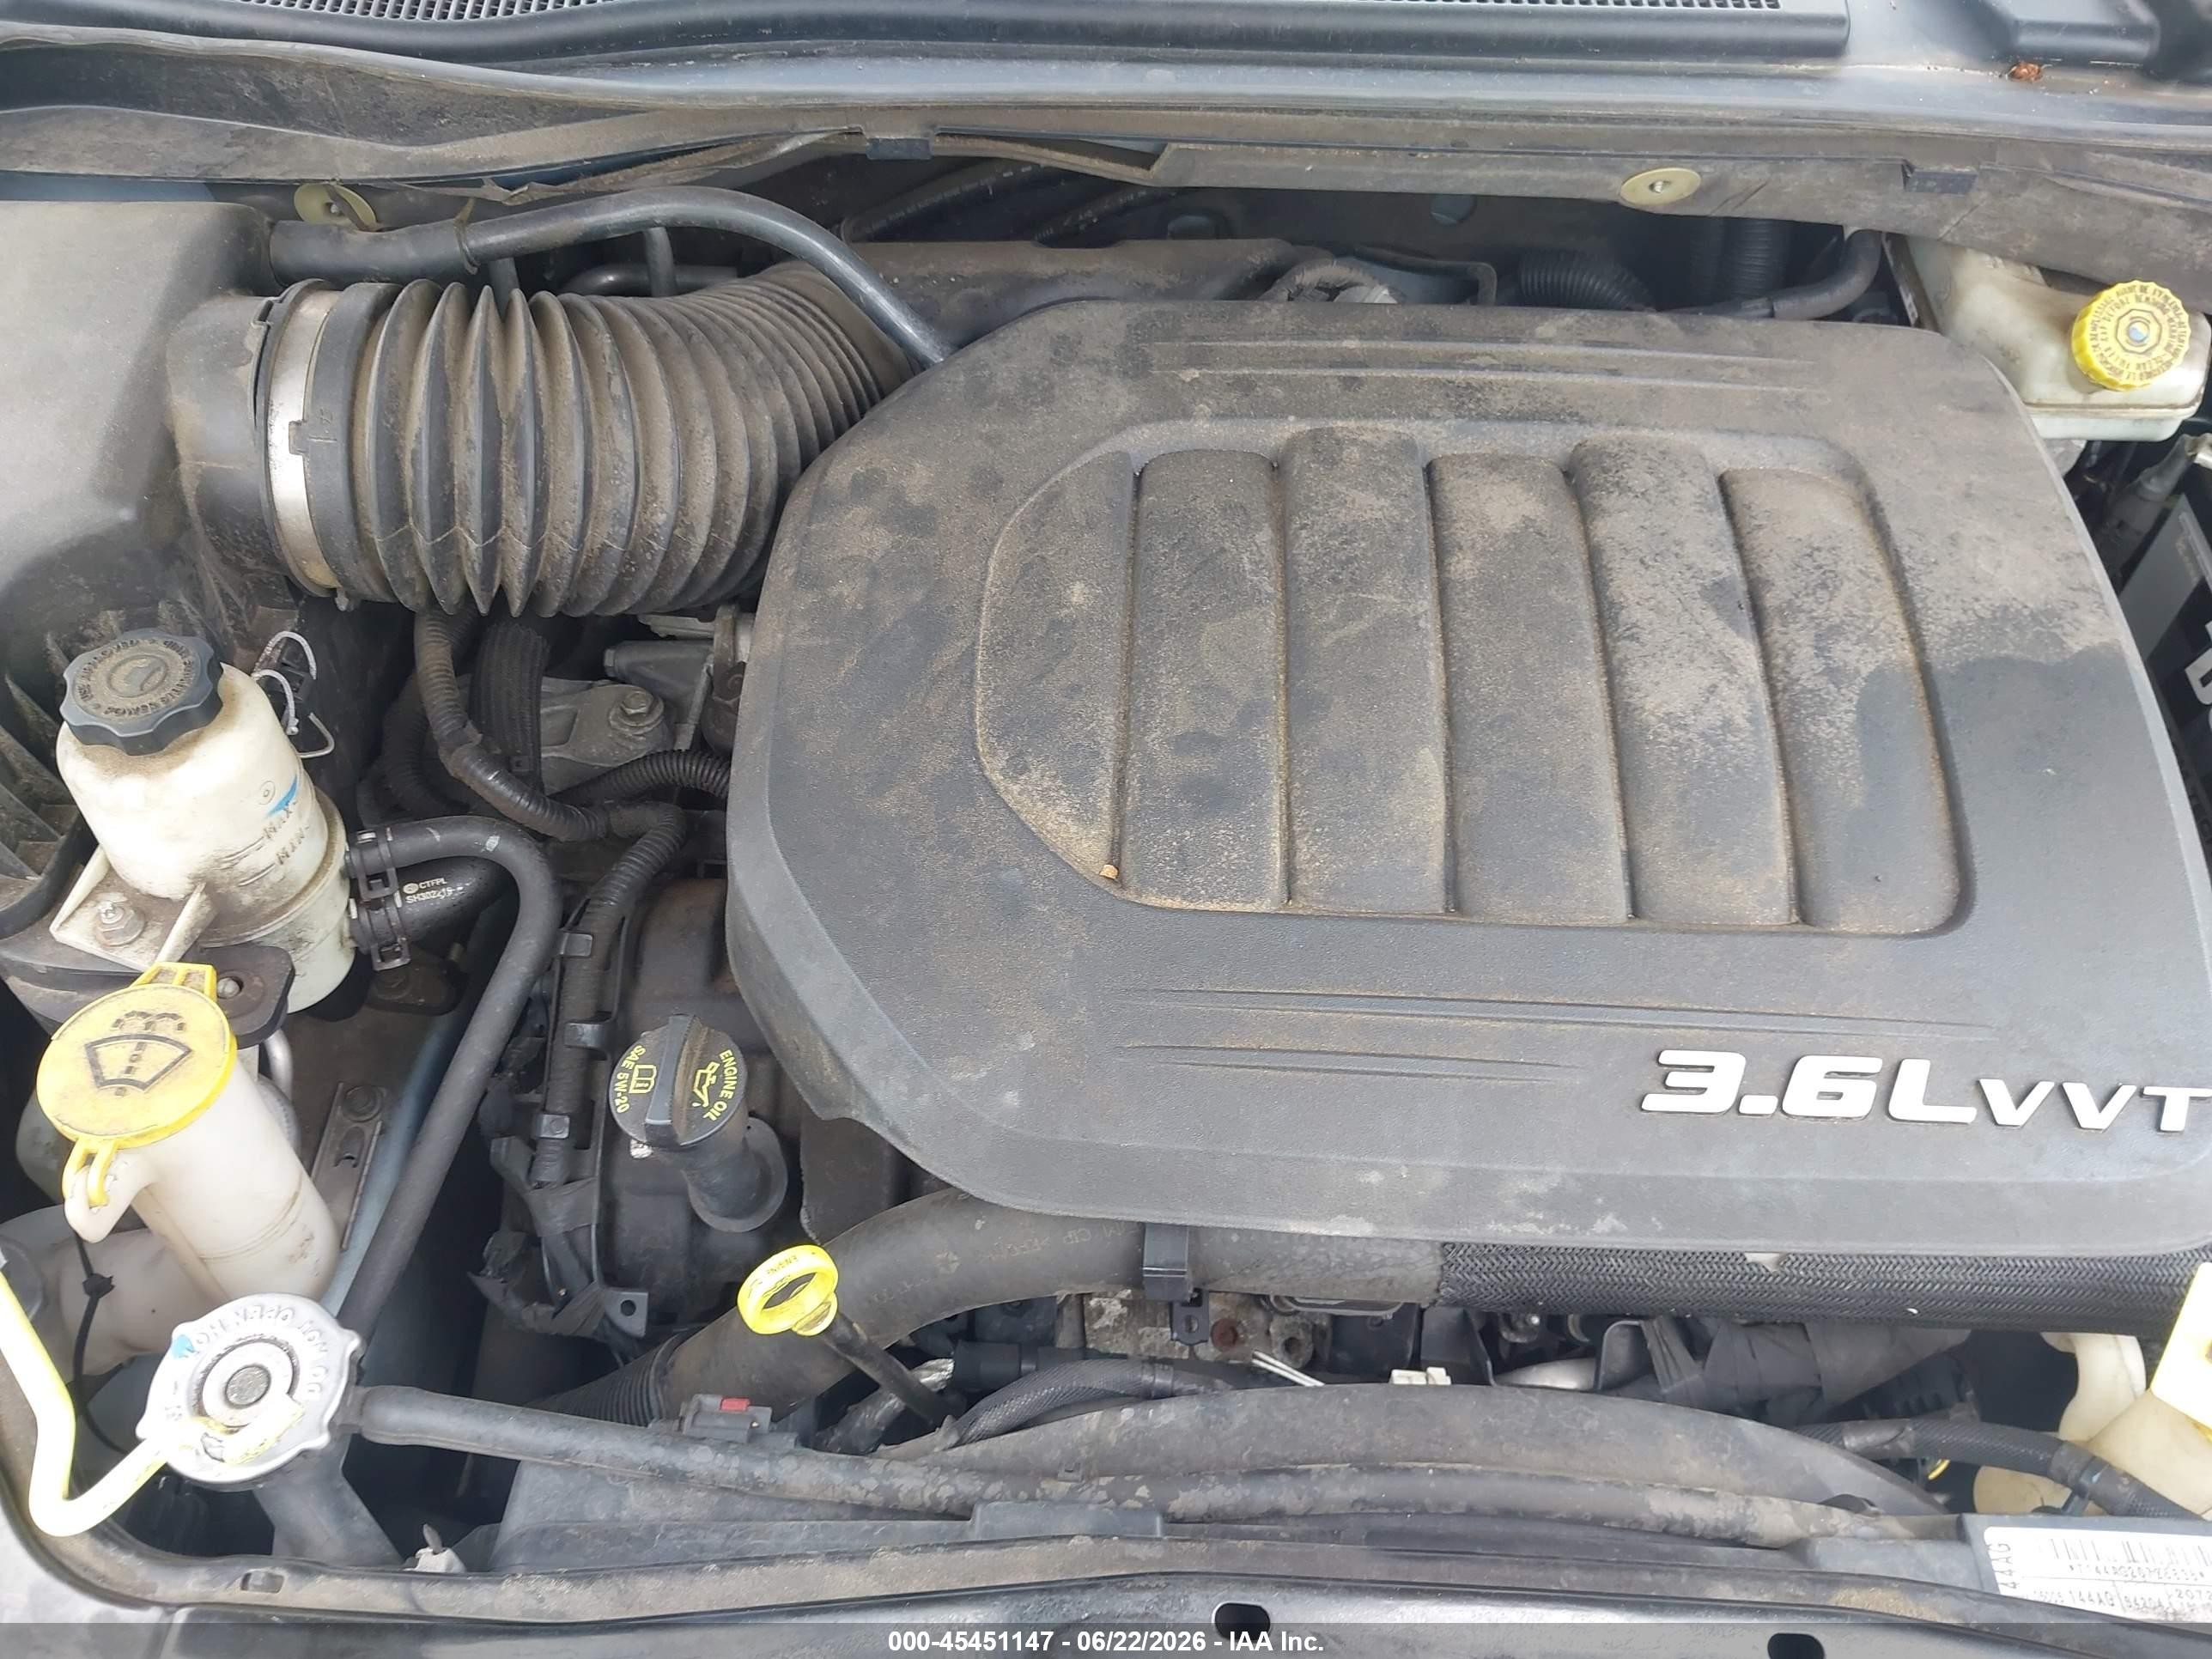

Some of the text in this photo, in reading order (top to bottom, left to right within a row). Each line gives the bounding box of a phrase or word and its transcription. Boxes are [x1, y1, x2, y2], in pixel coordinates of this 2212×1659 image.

[613, 1044, 647, 1114] SAE 5W-20
[702, 1049, 738, 1121] ENGINE OIL
[1978, 1077, 2212, 1132] VVT
